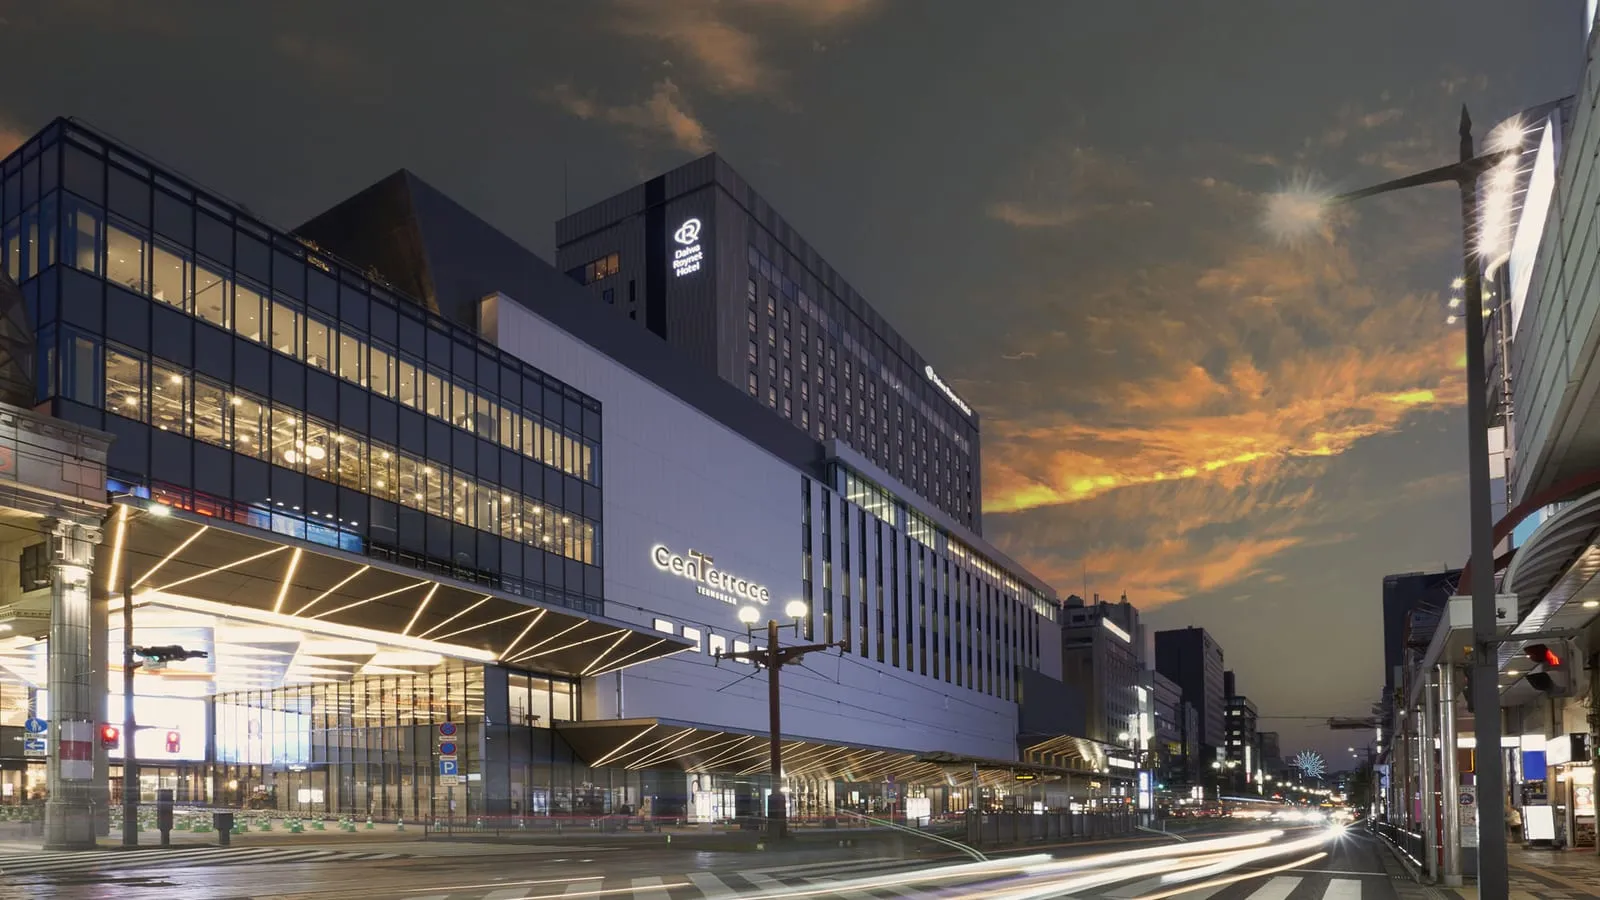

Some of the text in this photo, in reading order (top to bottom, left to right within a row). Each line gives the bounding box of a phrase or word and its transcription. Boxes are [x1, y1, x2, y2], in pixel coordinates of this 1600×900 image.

[675, 244, 701, 259] Daiwa
[673, 251, 703, 269] Roynet
[676, 261, 700, 277] Hotel
[652, 546, 769, 603] CenTerrace
[444, 761, 455, 774] P
